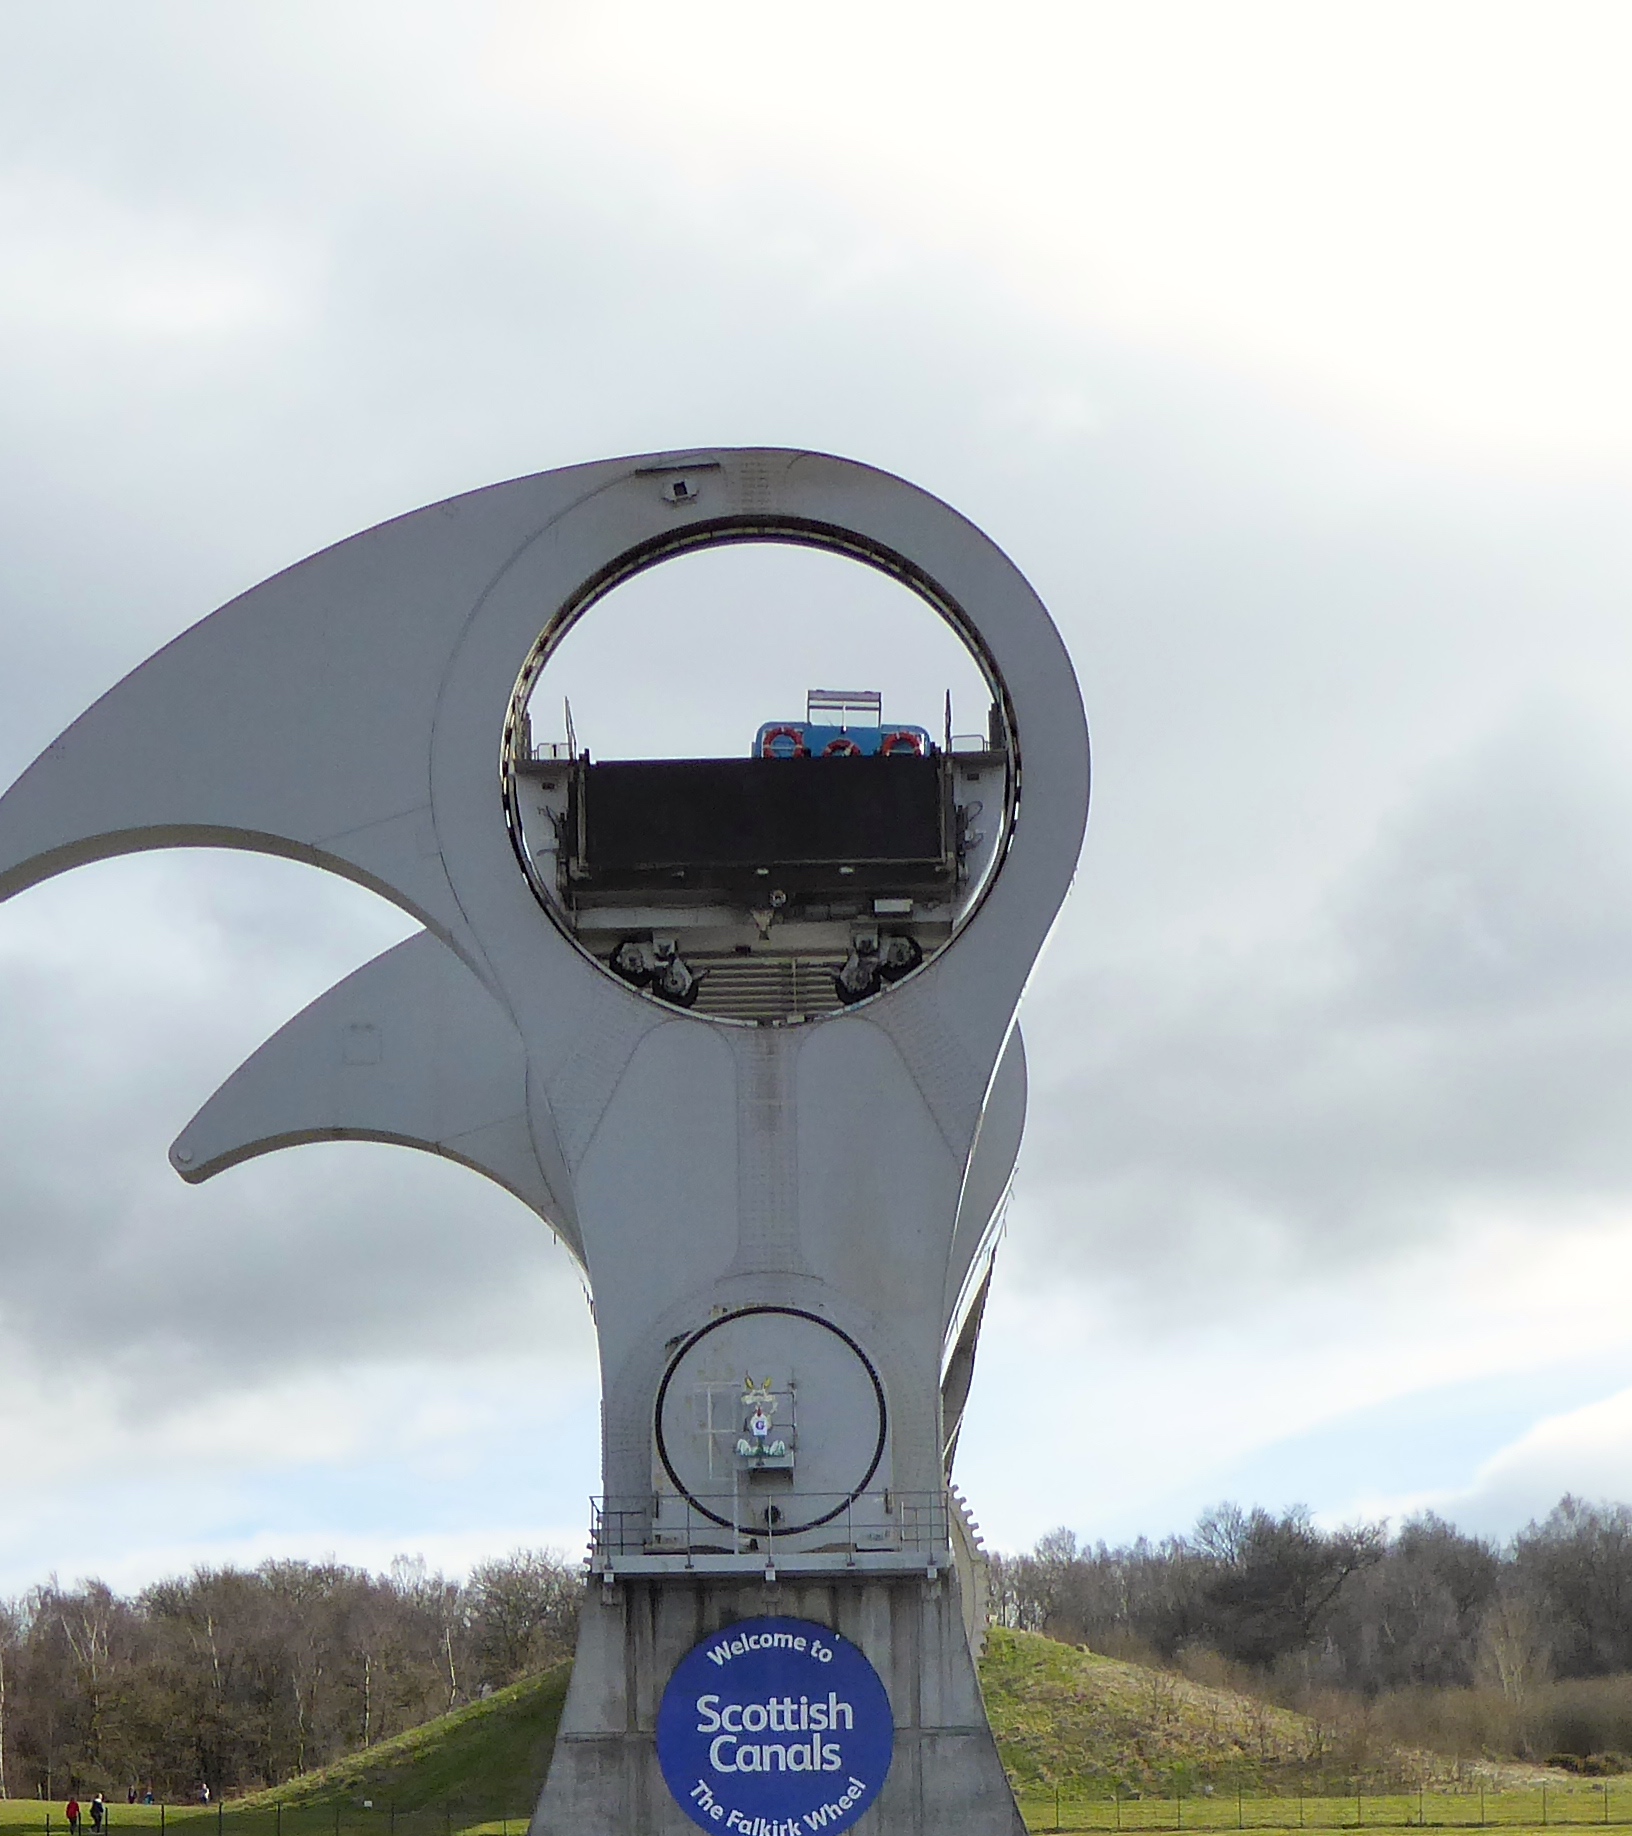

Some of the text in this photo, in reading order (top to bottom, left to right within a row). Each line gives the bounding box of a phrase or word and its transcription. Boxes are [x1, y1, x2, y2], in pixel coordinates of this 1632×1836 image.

[707, 1633, 833, 1666] Welcome to
[696, 1692, 854, 1732] Scottish
[709, 1732, 842, 1772] Canals
[690, 1779, 724, 1821] The
[803, 1776, 866, 1831] Wheel
